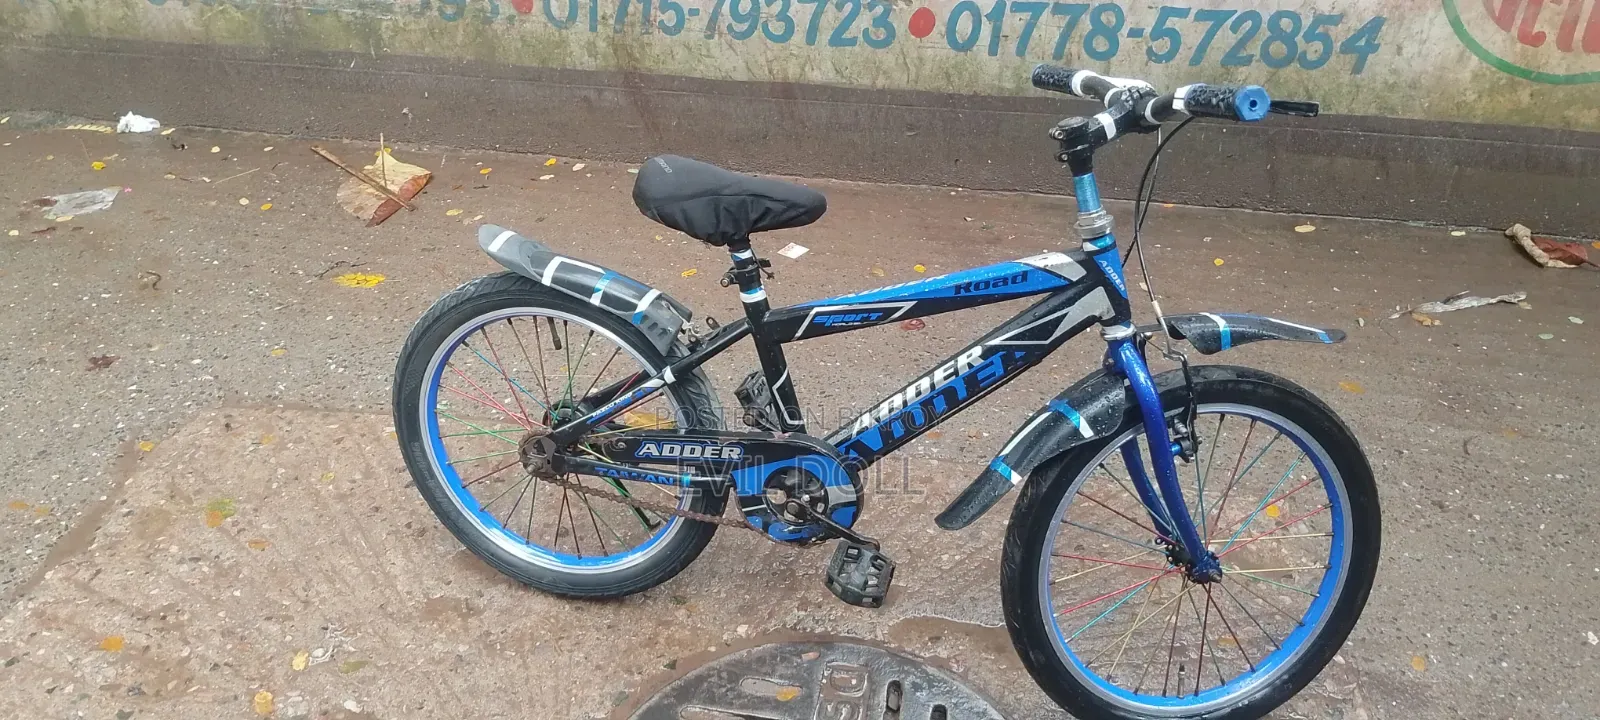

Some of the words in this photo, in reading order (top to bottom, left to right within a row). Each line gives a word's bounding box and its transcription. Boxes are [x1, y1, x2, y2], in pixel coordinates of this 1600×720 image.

[946, 0, 1387, 75] 01778-572854
[954, 270, 1029, 295] Road
[1098, 260, 1126, 291] ADDER
[850, 345, 985, 439] ADDER
[636, 442, 743, 460] ADDER
